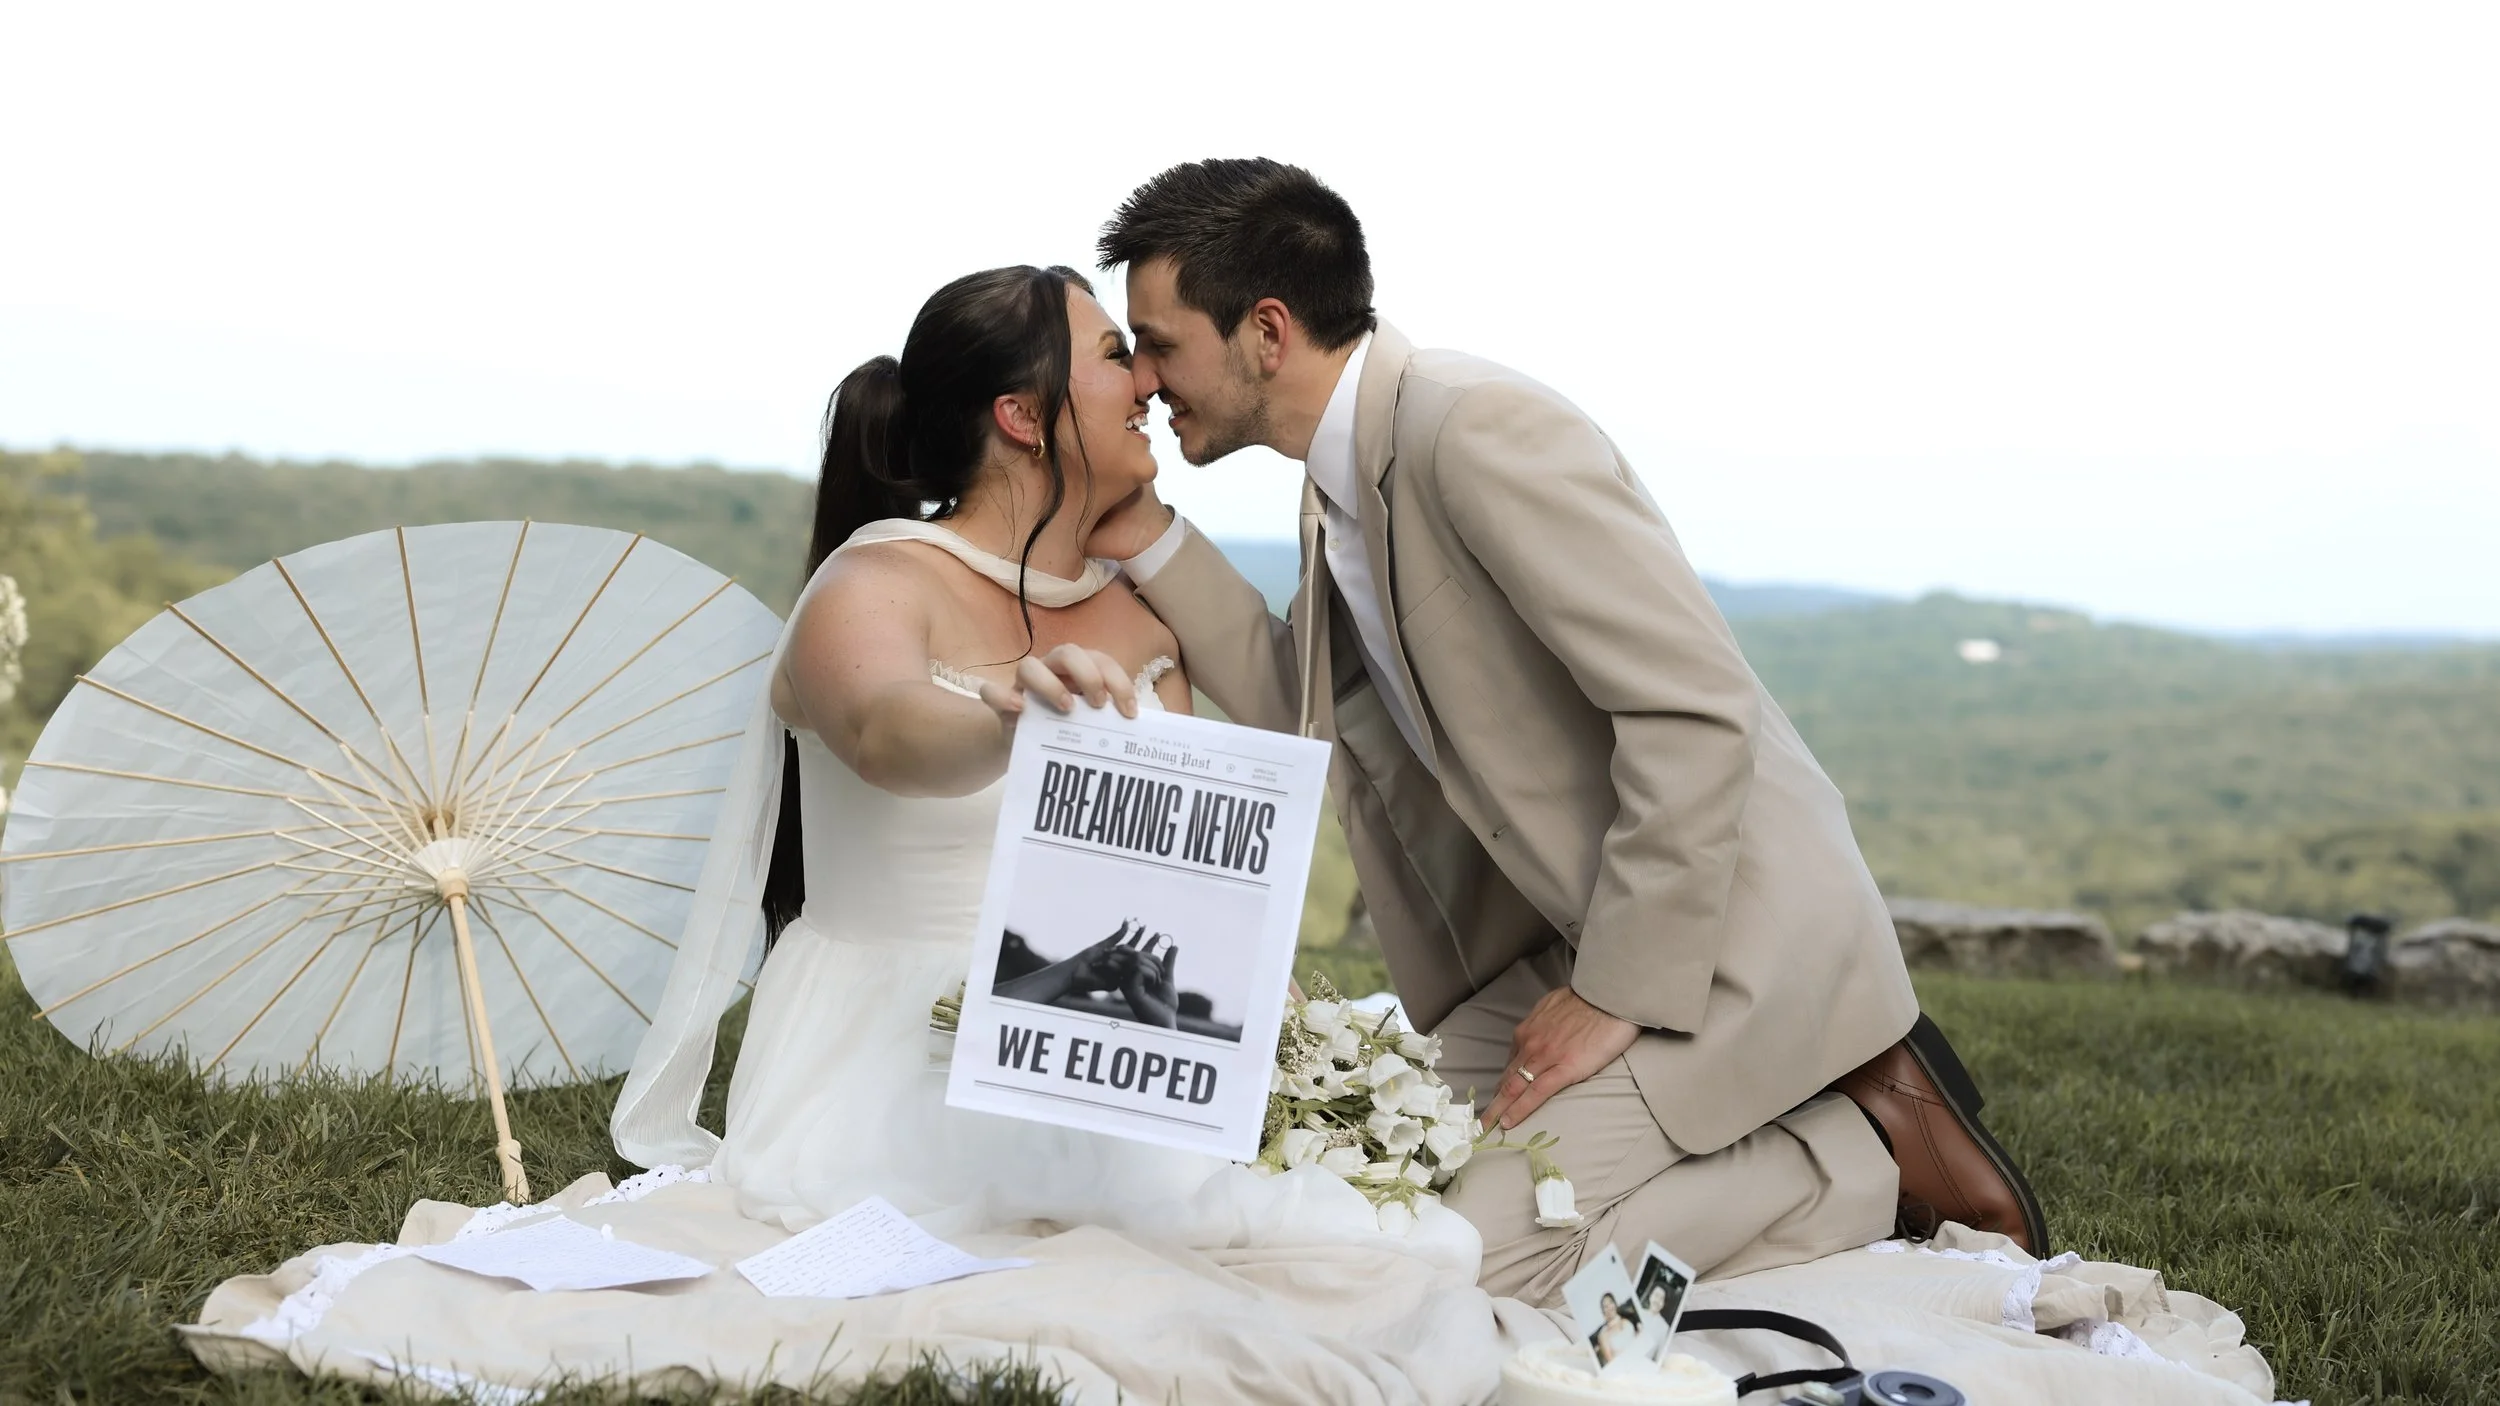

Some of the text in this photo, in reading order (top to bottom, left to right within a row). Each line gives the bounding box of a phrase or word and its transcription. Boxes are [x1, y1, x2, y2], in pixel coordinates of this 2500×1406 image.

[1124, 741, 1177, 765] Wedding
[1181, 752, 1210, 770] Post
[1034, 760, 1276, 875] BREAKING NEWS
[998, 1024, 1217, 1105] WE ELOPED
